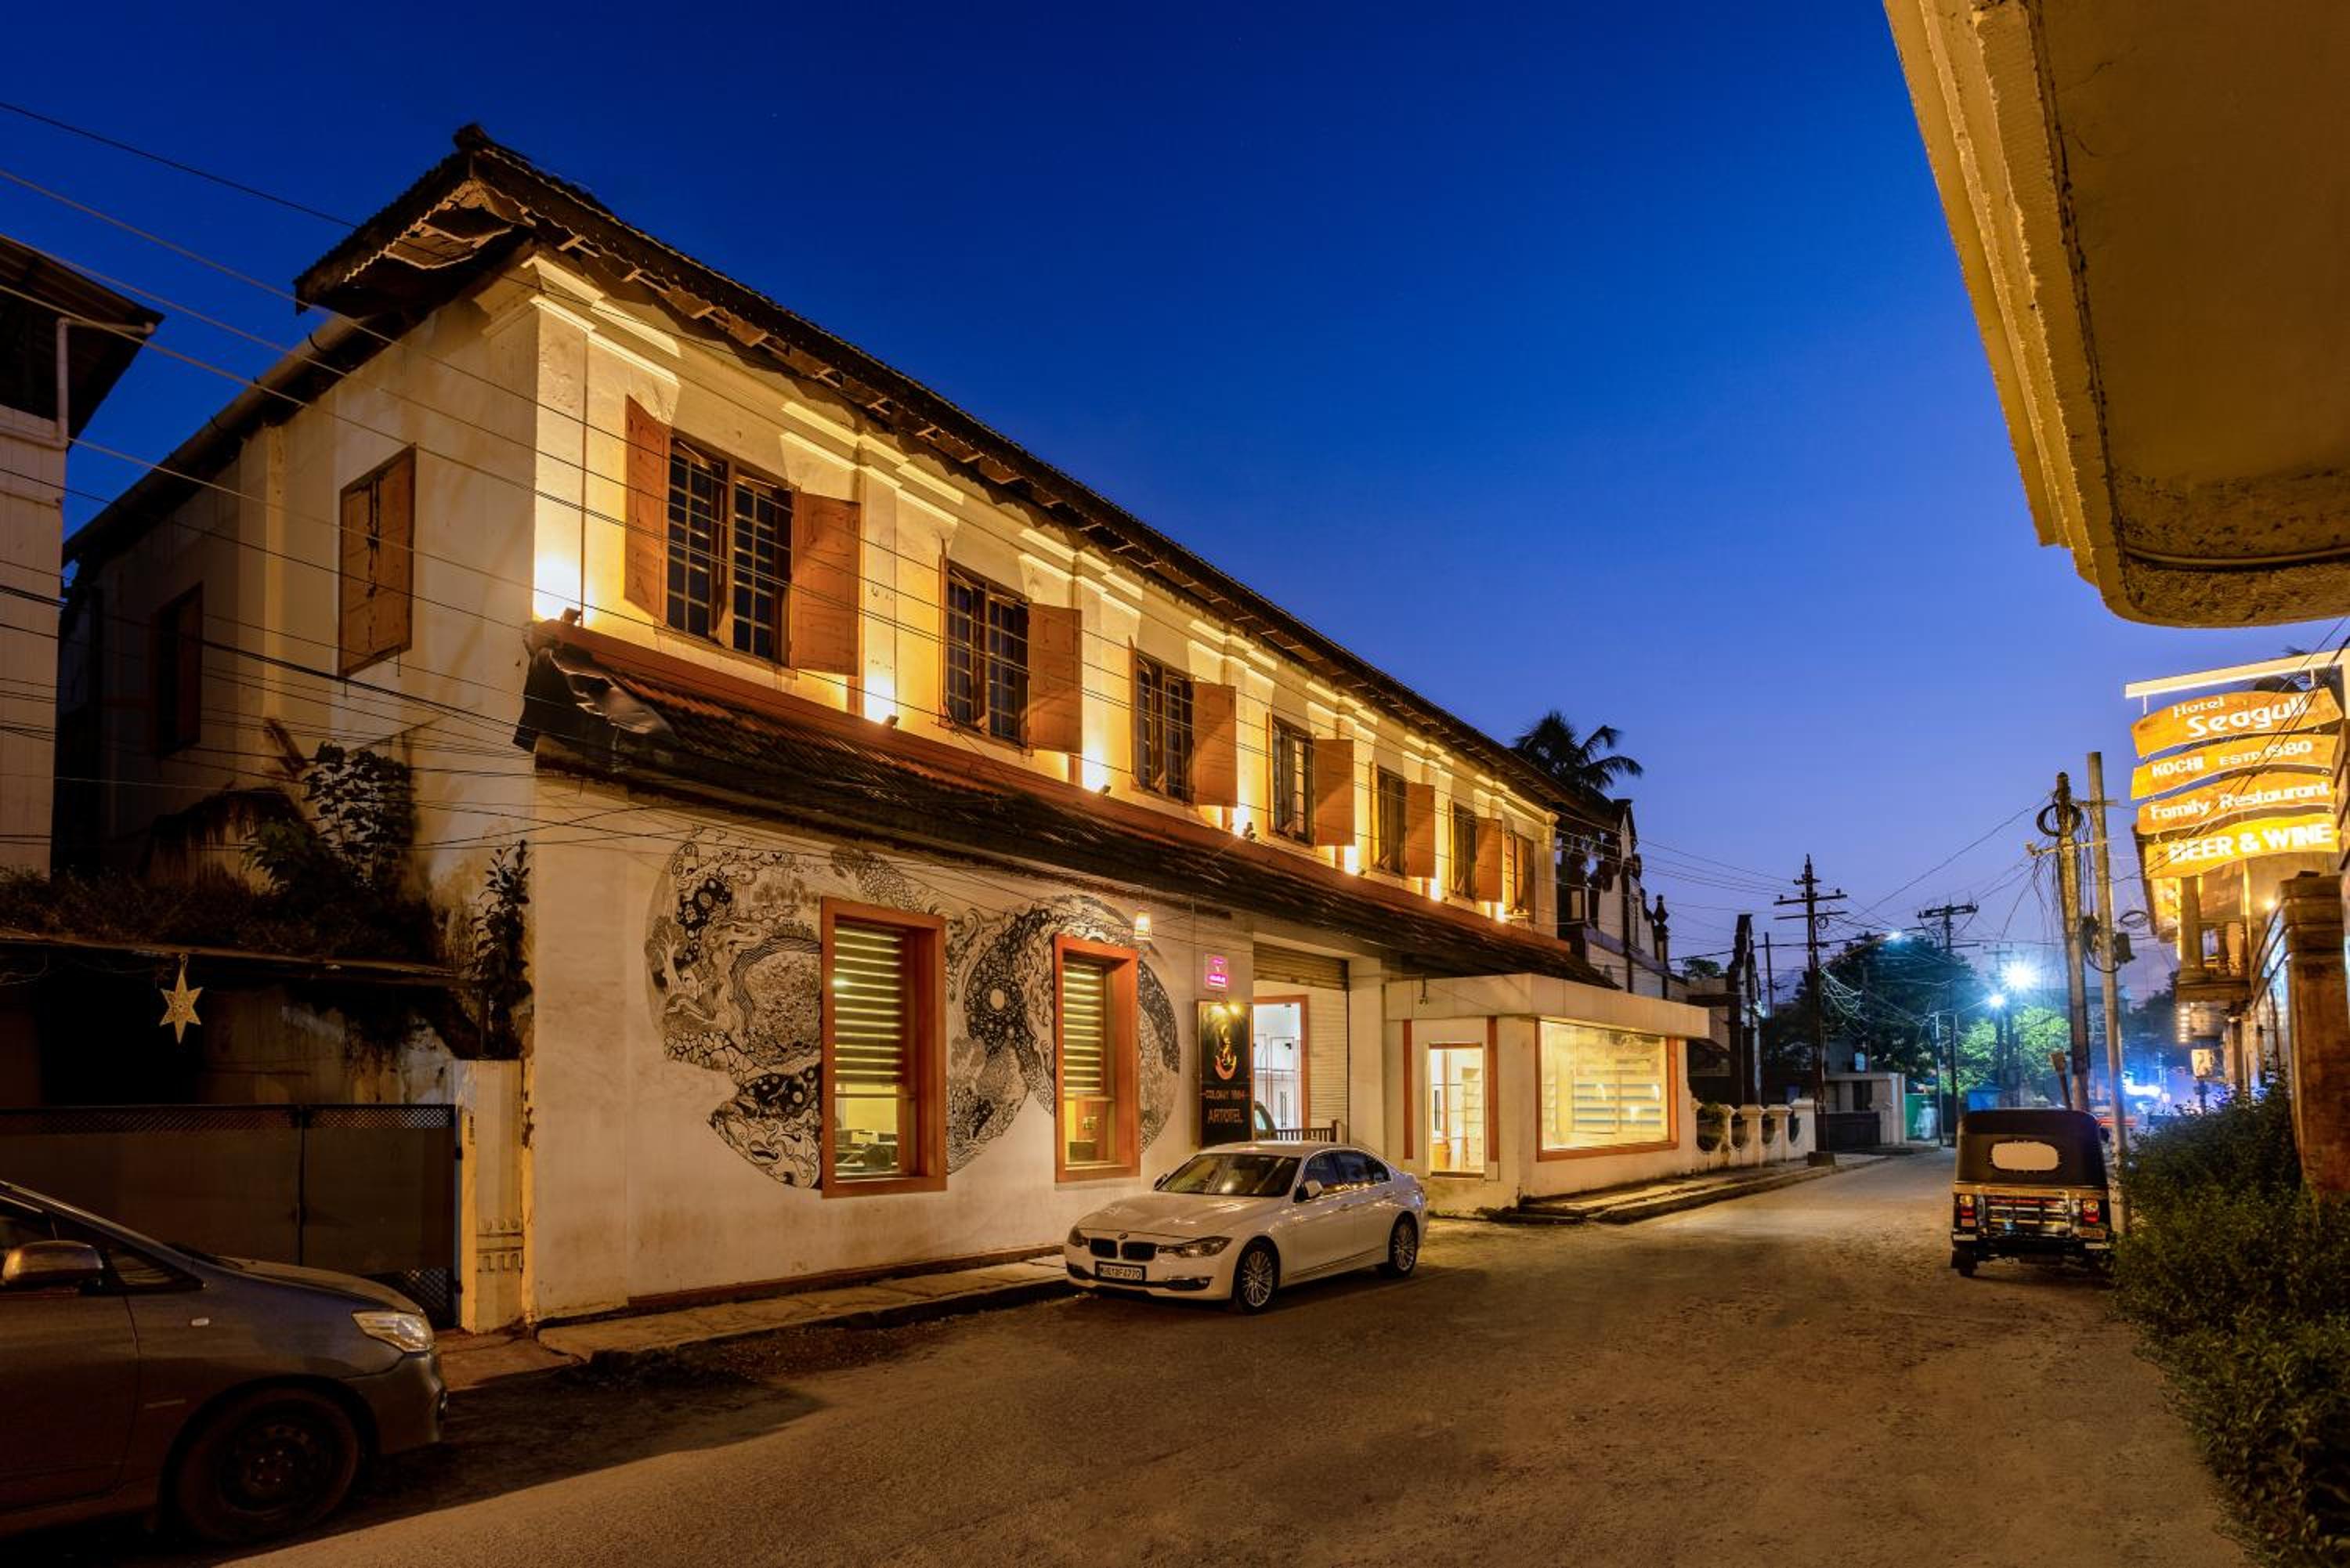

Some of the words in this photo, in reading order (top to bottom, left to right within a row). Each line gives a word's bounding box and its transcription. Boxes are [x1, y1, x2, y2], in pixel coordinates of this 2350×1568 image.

[2172, 696, 2225, 718] Hotel
[2187, 696, 2308, 737] Seagull
[2152, 757, 2204, 777] KOCHI
[2218, 750, 2261, 765] ESTD
[2149, 799, 2211, 821] Family
[2219, 782, 2329, 808] Restaurant
[2167, 836, 2233, 865] BEER
[2239, 833, 2260, 853] &
[2262, 823, 2332, 847] WINE
